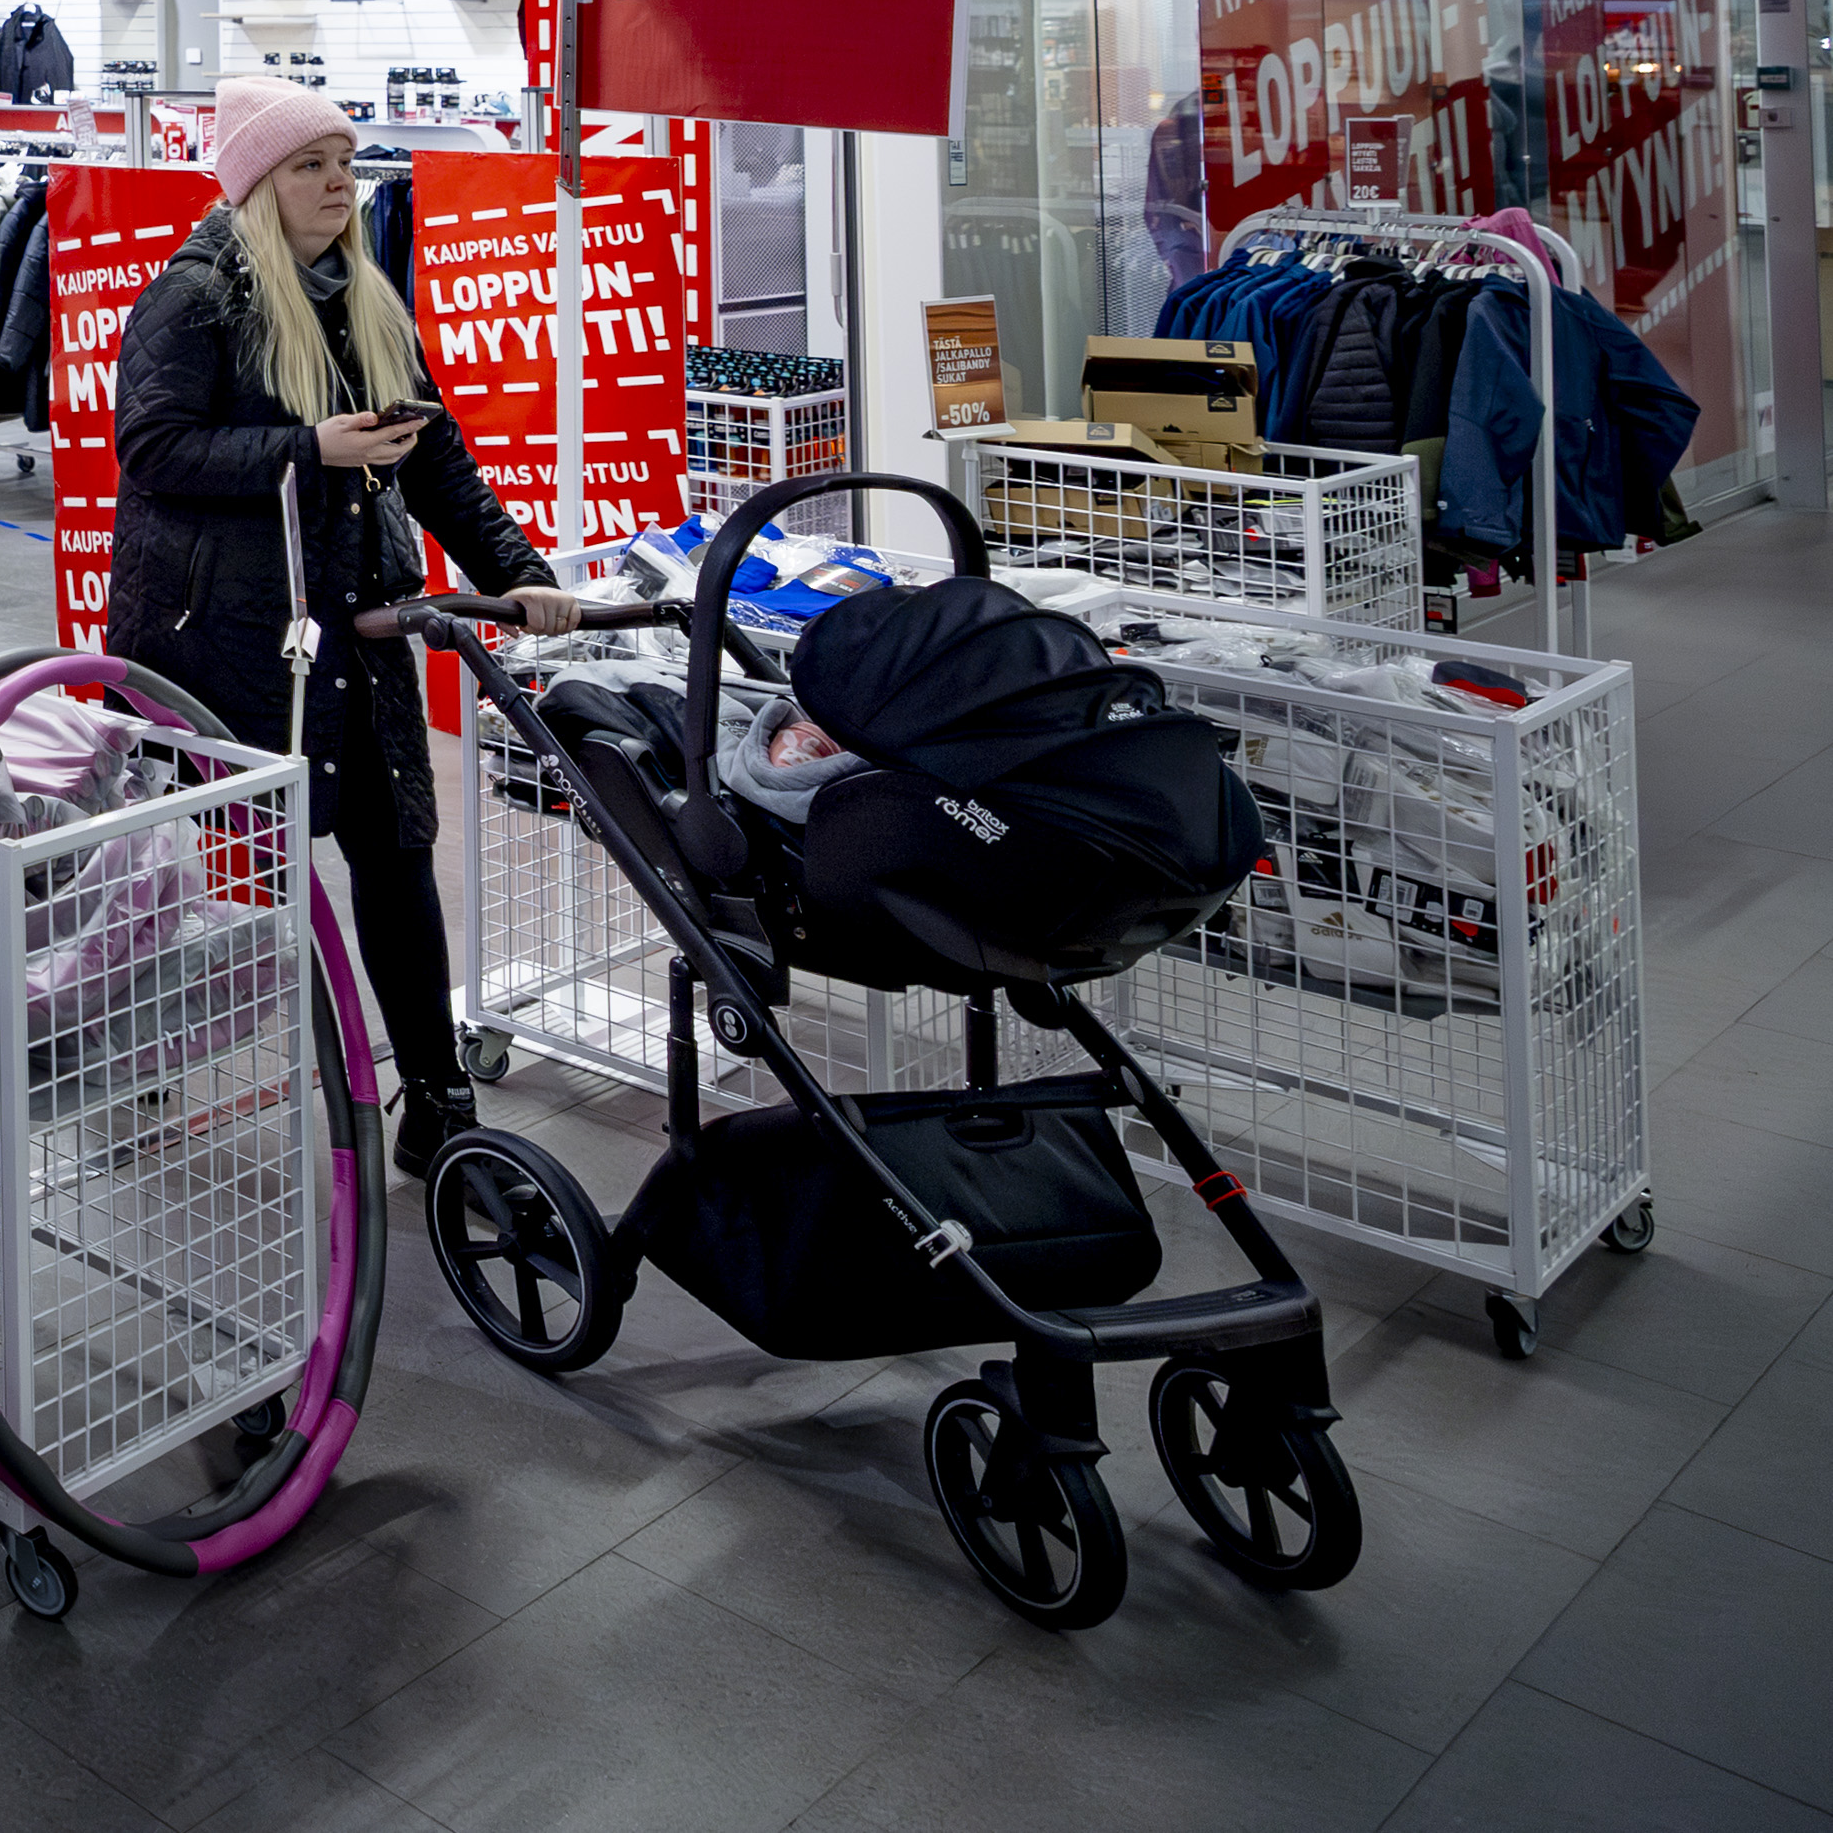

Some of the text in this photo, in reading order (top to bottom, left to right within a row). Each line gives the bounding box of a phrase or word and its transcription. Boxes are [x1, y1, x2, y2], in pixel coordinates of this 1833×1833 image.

[1352, 185, 1380, 200] 20€
[422, 222, 645, 266] KAUPPIAS VAHTUU
[56, 262, 142, 296] KAUPPIAS
[933, 336, 962, 350] TÄSTÄ
[935, 347, 992, 362] JALKAPALLO
[936, 358, 990, 374] /SALIBANDY
[936, 371, 967, 385] SUKAT
[941, 402, 991, 426] -50%
[551, 768, 587, 809] nord
[934, 795, 1001, 844] römer
[966, 798, 1010, 834] britax
[882, 1197, 918, 1234] Active
